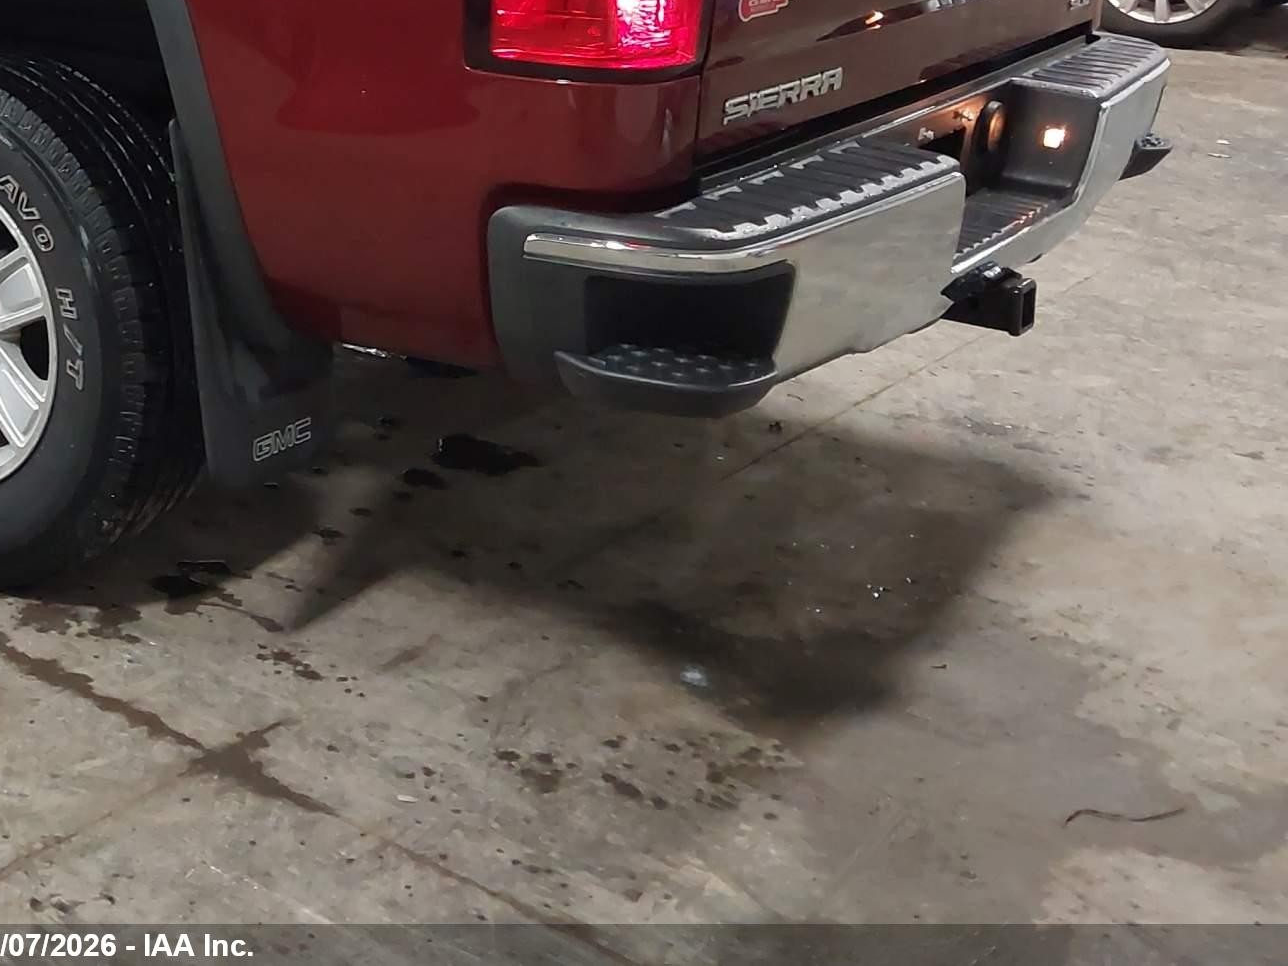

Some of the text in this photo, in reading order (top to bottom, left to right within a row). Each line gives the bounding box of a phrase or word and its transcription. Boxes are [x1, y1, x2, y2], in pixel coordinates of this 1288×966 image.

[723, 67, 842, 126] SIERRA
[55, 287, 85, 391] H/T
[253, 417, 312, 462] GMC
